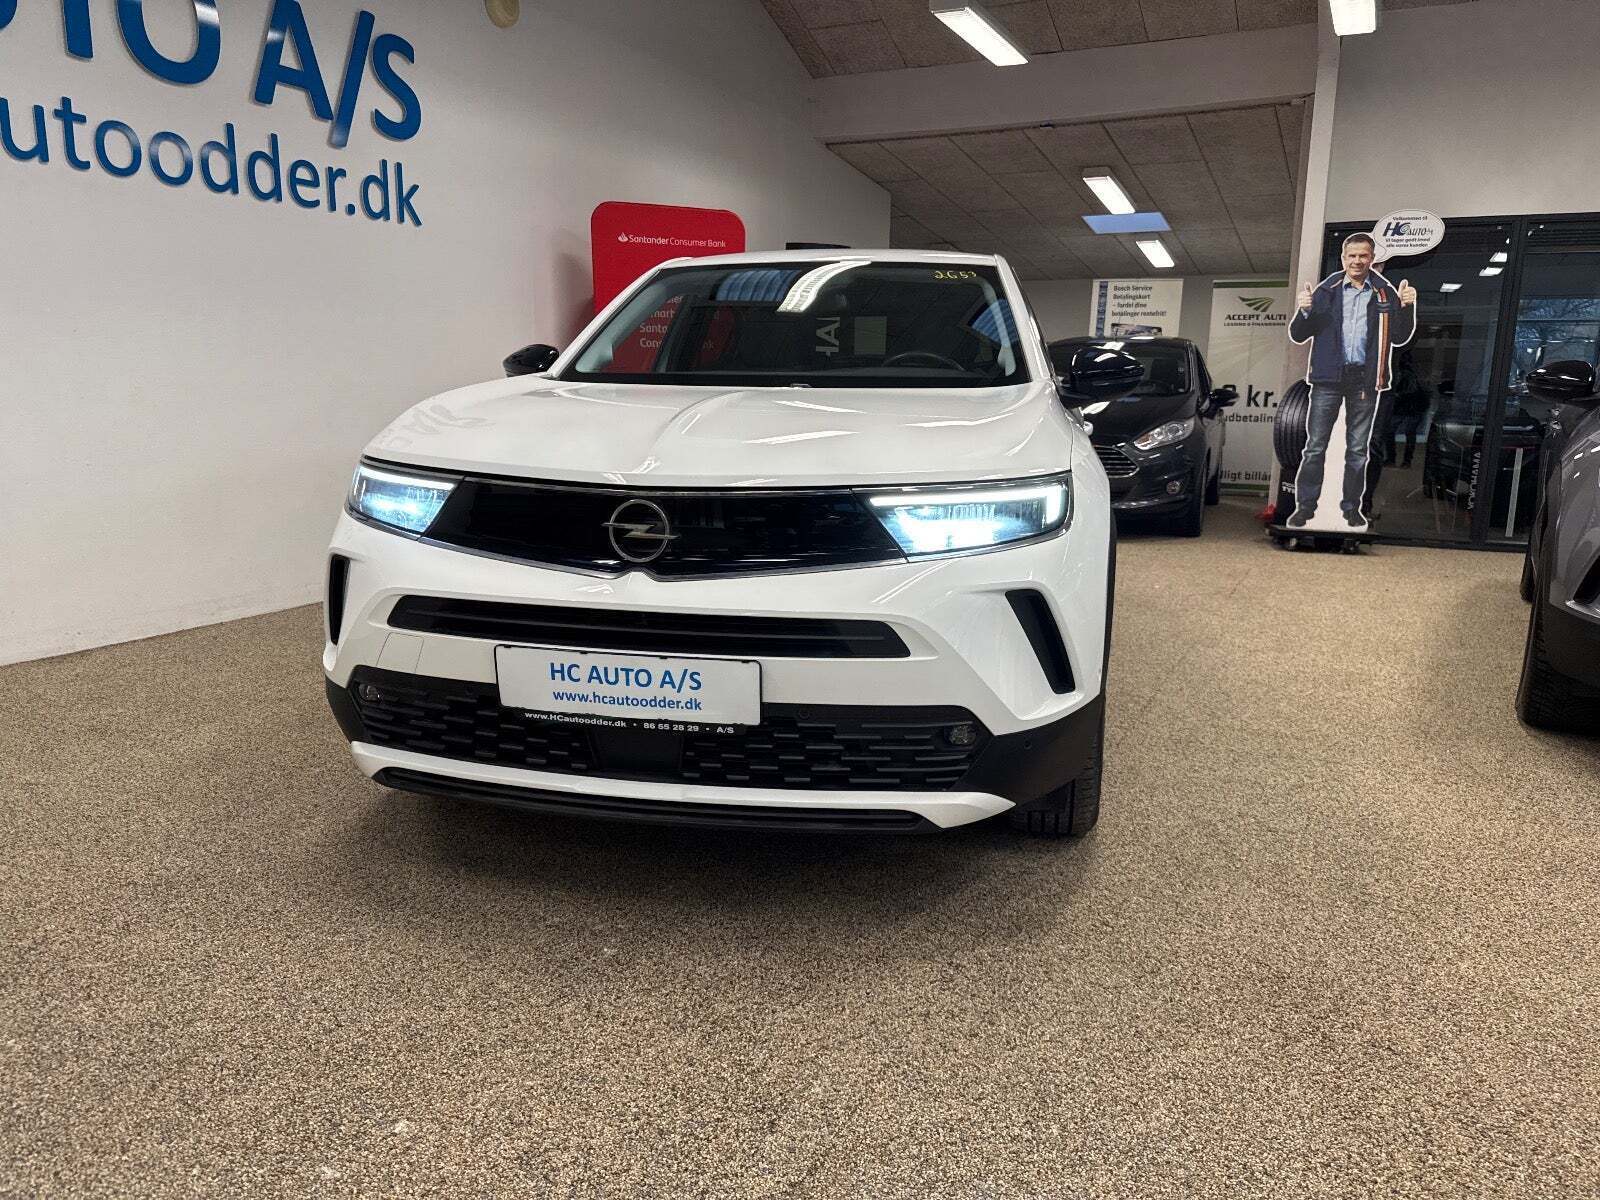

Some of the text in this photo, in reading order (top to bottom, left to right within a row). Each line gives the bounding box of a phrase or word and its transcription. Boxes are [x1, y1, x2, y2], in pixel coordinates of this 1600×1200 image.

[251, 0, 423, 149] A/S
[628, 234, 726, 248] Santander Consumer Bank
[1247, 384, 1278, 408] kr.
[550, 663, 702, 693] HC AUTO A/S
[553, 691, 702, 710] www.hcautoodder.dk
[525, 712, 626, 728] www.HCautoodder.dk
[658, 723, 670, 731] 55
